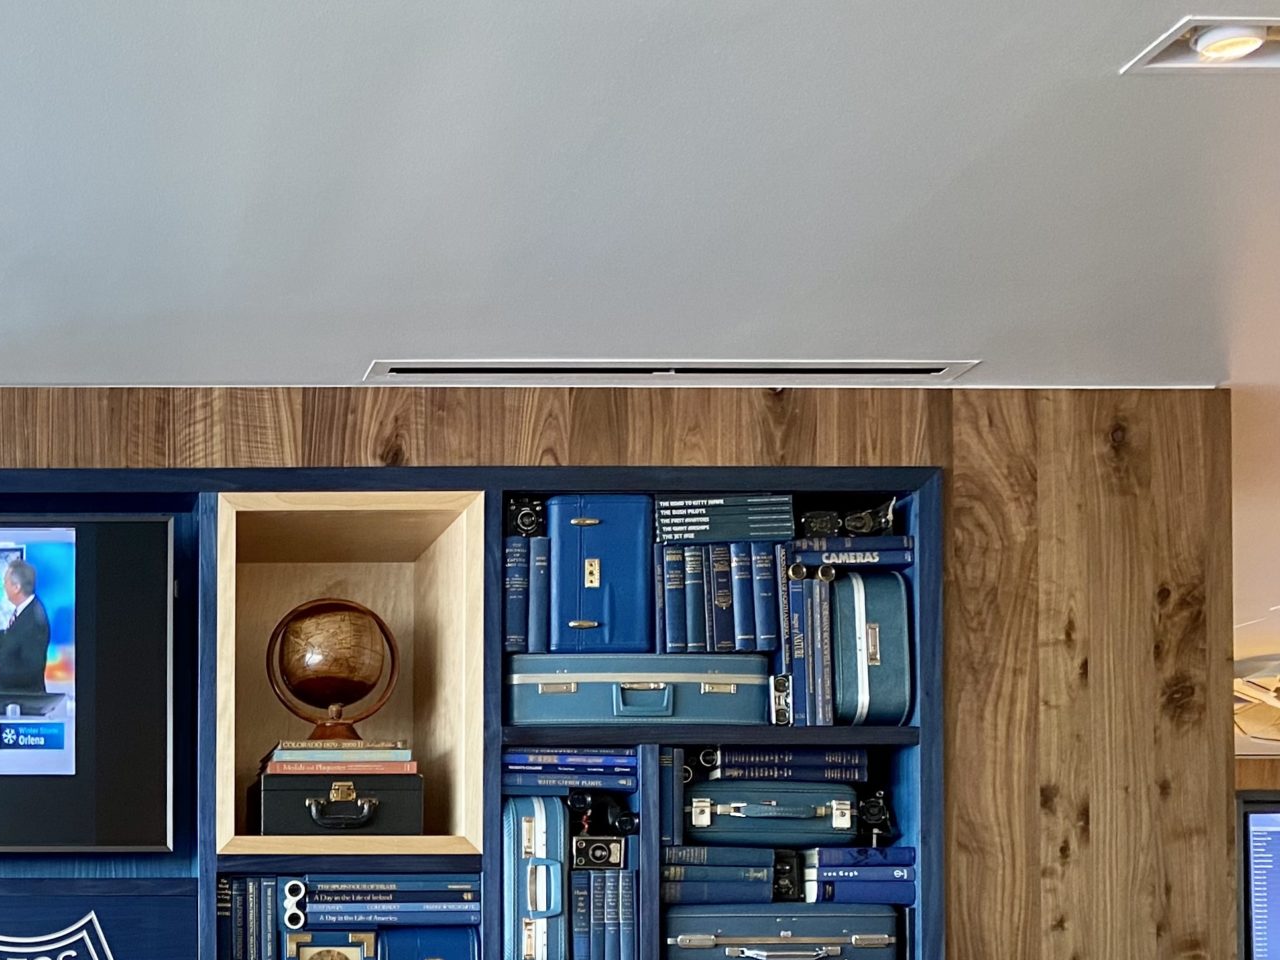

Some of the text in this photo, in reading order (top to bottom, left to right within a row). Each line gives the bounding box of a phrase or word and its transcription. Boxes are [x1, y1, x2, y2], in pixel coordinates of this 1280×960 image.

[822, 552, 880, 563] CAMERAS
[794, 634, 804, 658] NATURE
[19, 735, 44, 745] Orlena
